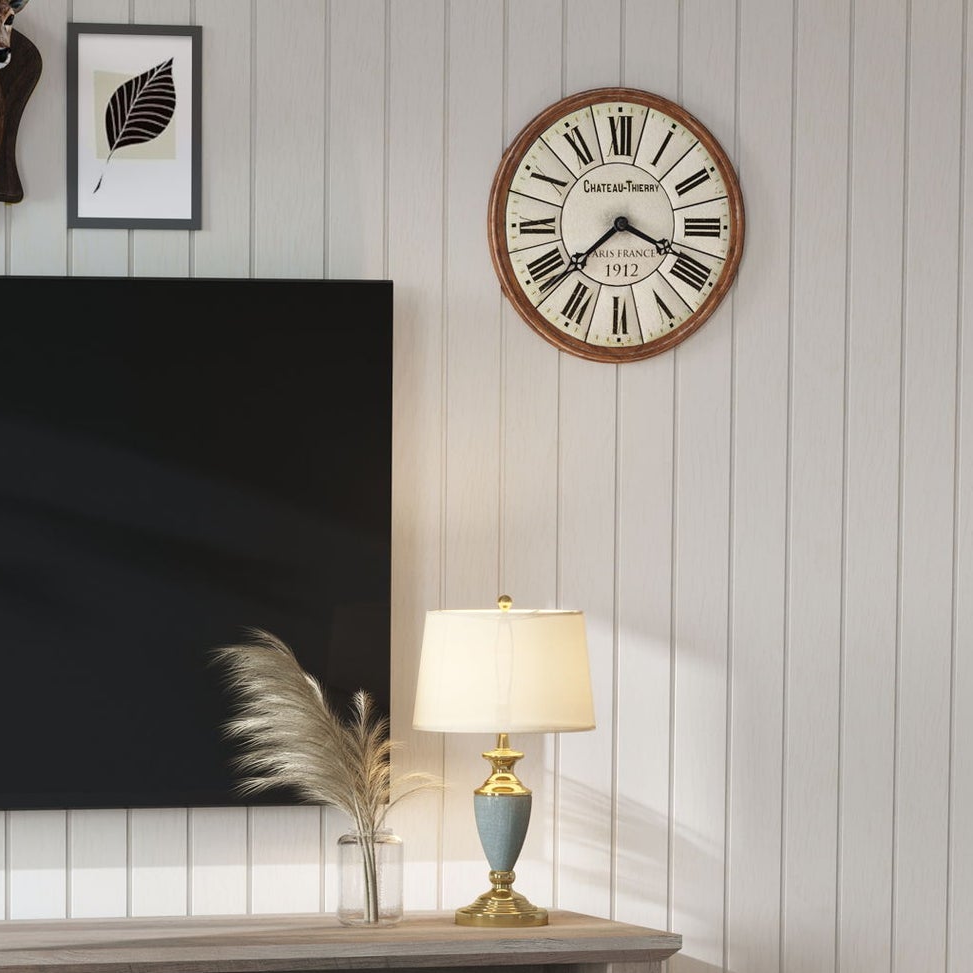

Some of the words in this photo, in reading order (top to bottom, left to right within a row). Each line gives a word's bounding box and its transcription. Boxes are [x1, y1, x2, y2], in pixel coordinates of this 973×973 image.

[607, 115, 633, 157] XII
[563, 125, 595, 170] XI
[675, 166, 712, 197] II
[519, 216, 556, 235] IX
[684, 217, 721, 238] III
[617, 249, 657, 258] FRANCE
[605, 263, 639, 277] 1912
